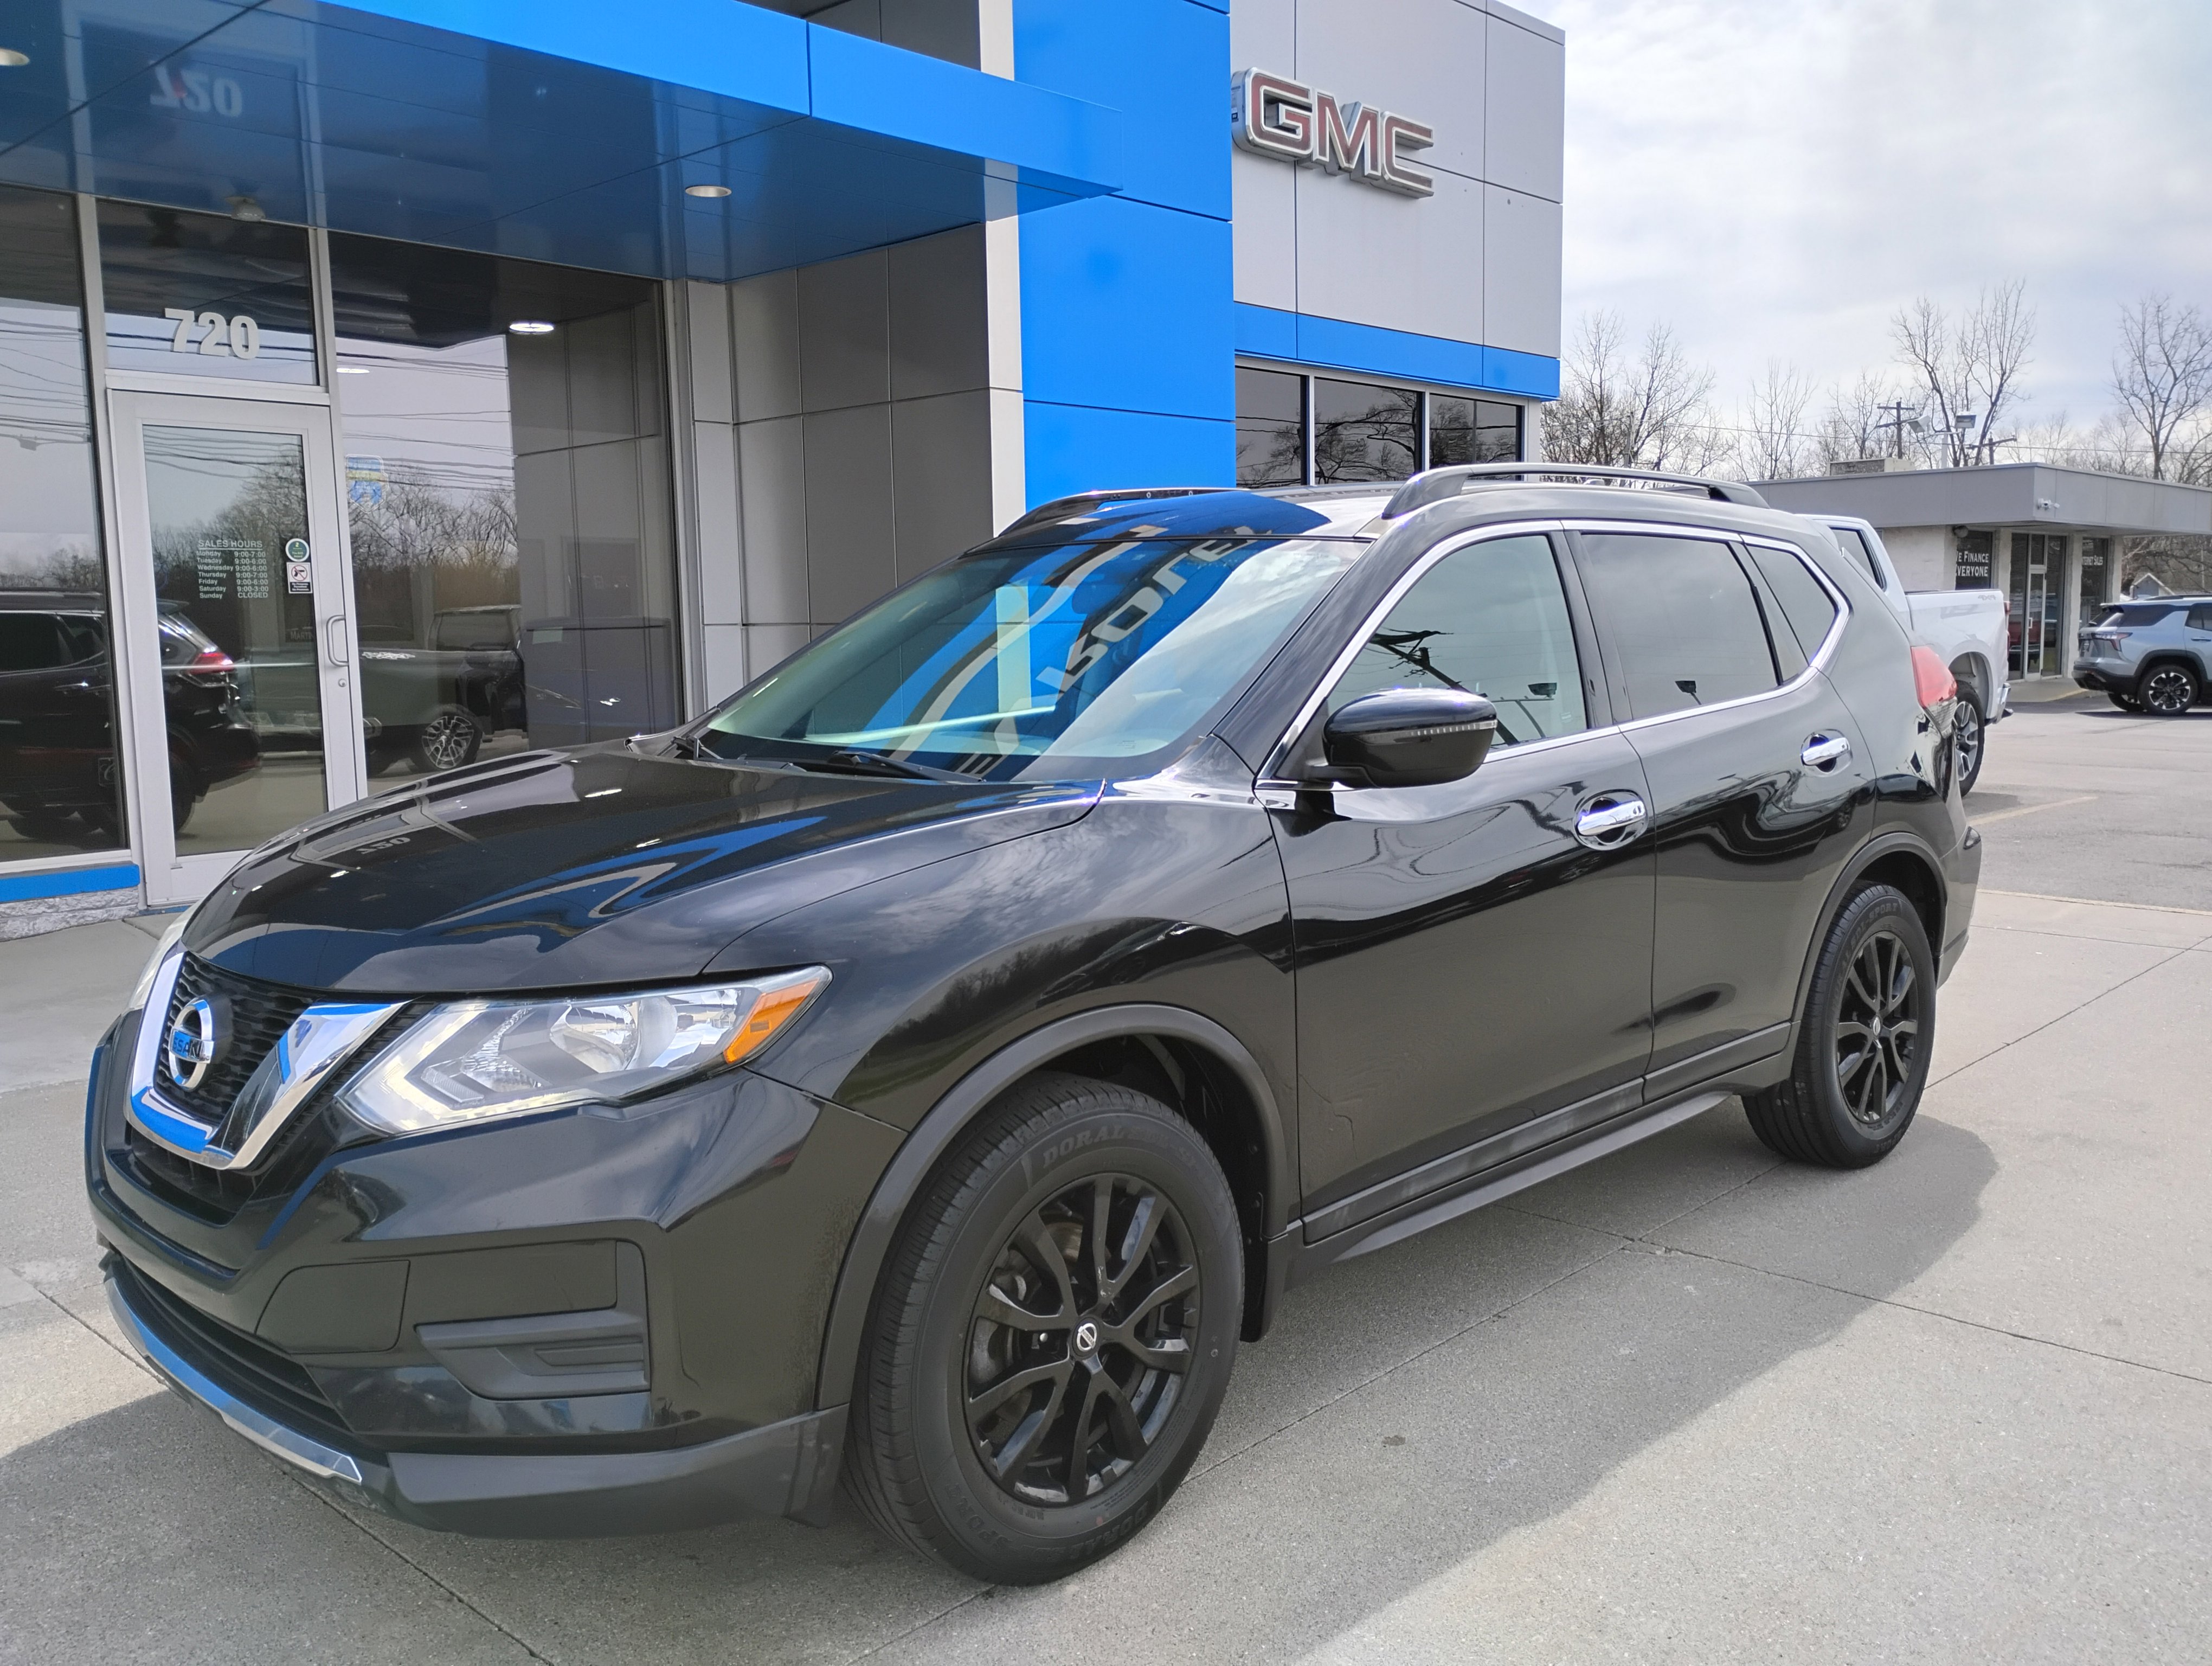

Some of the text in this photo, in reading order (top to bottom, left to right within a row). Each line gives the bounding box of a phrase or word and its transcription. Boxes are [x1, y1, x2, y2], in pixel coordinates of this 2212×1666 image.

[1239, 67, 1434, 197] GMC
[165, 308, 260, 359] 720
[198, 540, 228, 548] SALES
[1956, 550, 1989, 563] E FINANCE
[1956, 565, 1989, 577] VERYONE
[1043, 1124, 1126, 1169] DORAL
